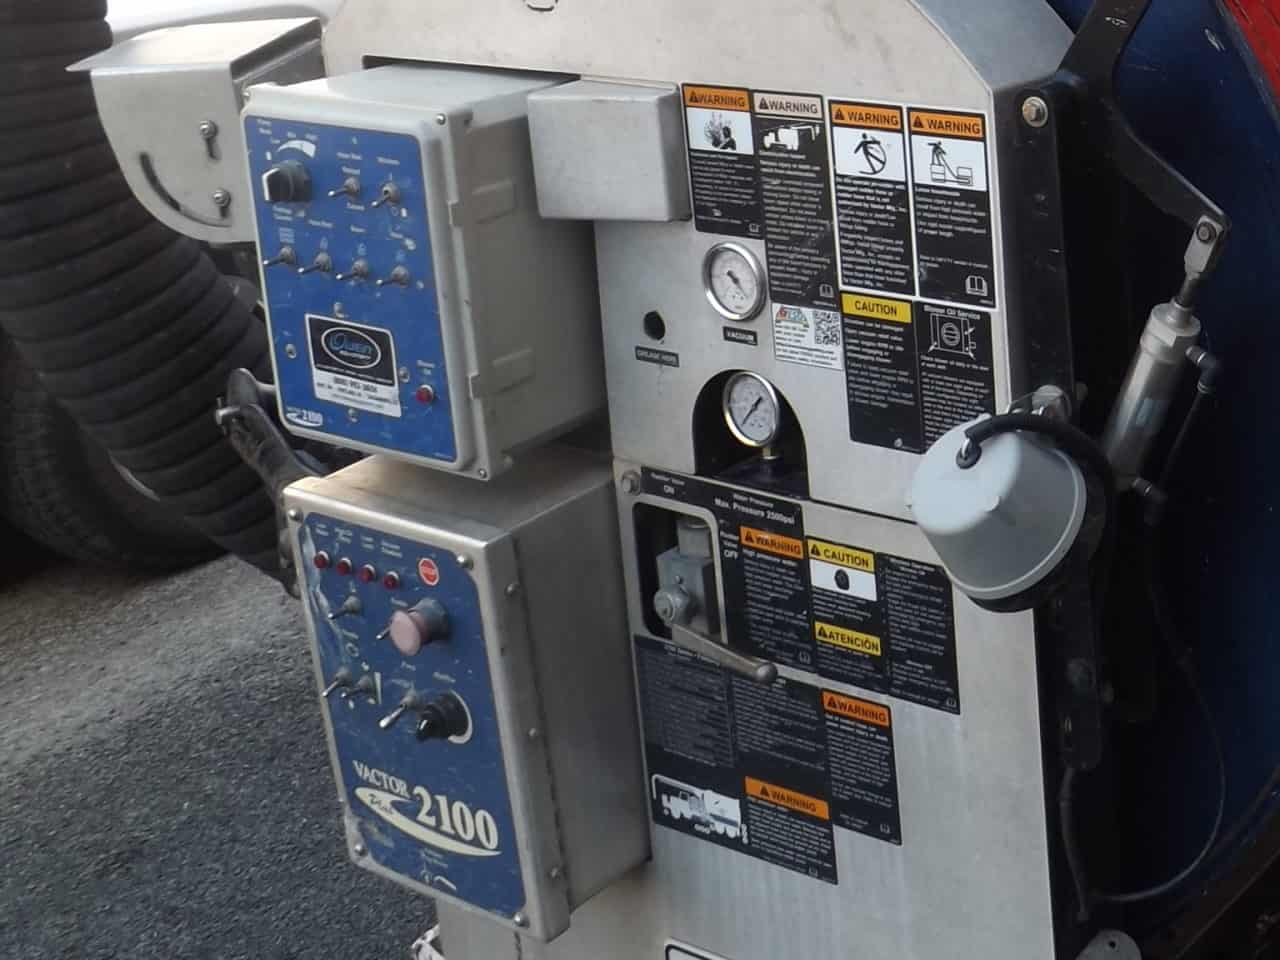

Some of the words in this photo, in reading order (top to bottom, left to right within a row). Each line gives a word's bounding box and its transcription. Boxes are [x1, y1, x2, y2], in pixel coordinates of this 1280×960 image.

[697, 93, 745, 107] WARNING
[768, 100, 818, 114] WARNING
[847, 111, 899, 126] WARNING
[927, 119, 981, 134] WARNING
[854, 299, 898, 316] CAUTION
[756, 536, 801, 553] WARNING
[824, 548, 869, 568] CAUTION
[828, 631, 879, 652] ATENCIÓN
[838, 701, 887, 723] WARNING
[353, 760, 410, 798] VACTOR
[772, 791, 817, 813] WARNING
[414, 786, 499, 850] 2100
